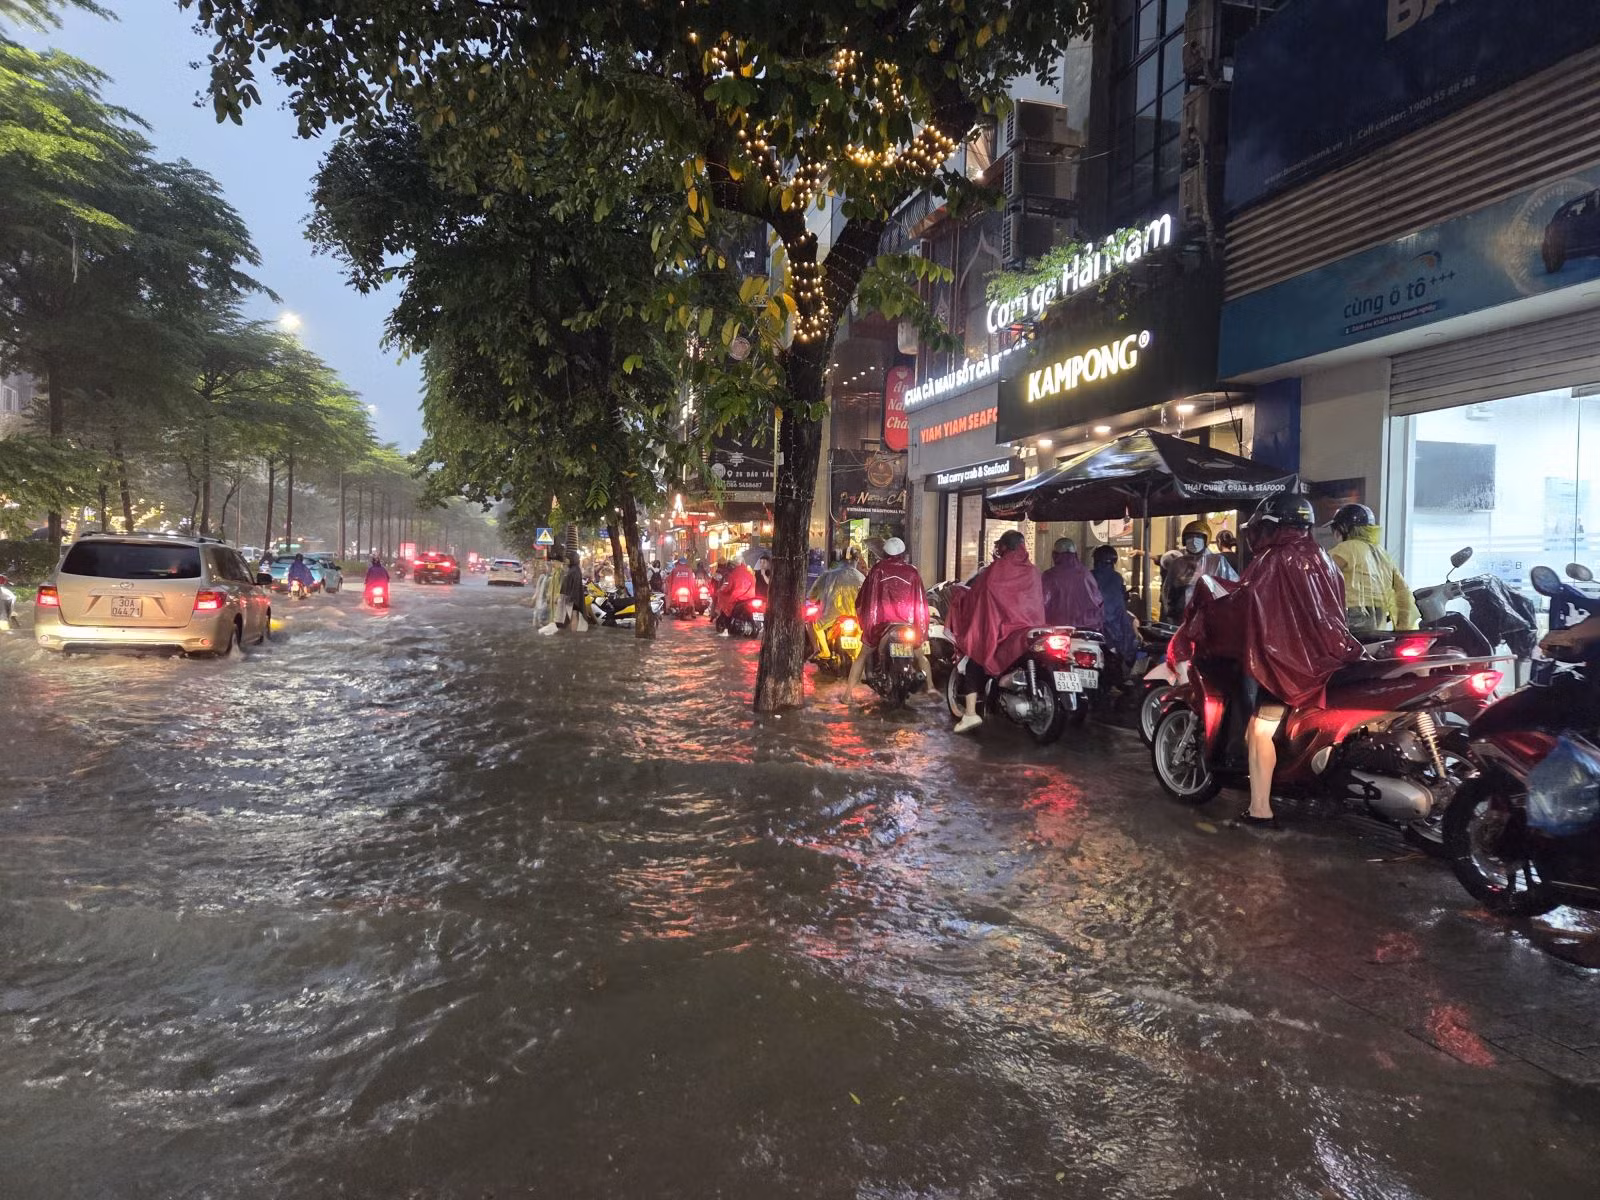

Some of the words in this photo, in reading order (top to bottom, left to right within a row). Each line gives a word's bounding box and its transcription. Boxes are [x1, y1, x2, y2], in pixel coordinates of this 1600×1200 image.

[1357, 123, 1374, 140] Call
[1375, 109, 1407, 131] center:
[1408, 96, 1432, 115] 1900
[1062, 242, 1101, 296] Hải
[1104, 213, 1171, 274] Nam
[1343, 295, 1385, 319] cùng
[905, 386, 923, 407] CUA
[934, 372, 956, 395] MAU
[921, 424, 942, 443] YIAM
[944, 416, 967, 438] YIAM
[937, 473, 949, 485] Thai
[949, 471, 965, 484] curry
[964, 467, 978, 480] crab
[977, 466, 984, 477] &
[983, 460, 1010, 477] Seafood
[1184, 483, 1201, 491] THAI
[1202, 483, 1226, 493] CURRY
[1227, 483, 1247, 492] CRAB
[1248, 483, 1254, 491] &
[1254, 483, 1286, 492] SEAFOOD
[119, 598, 135, 608] 30A
